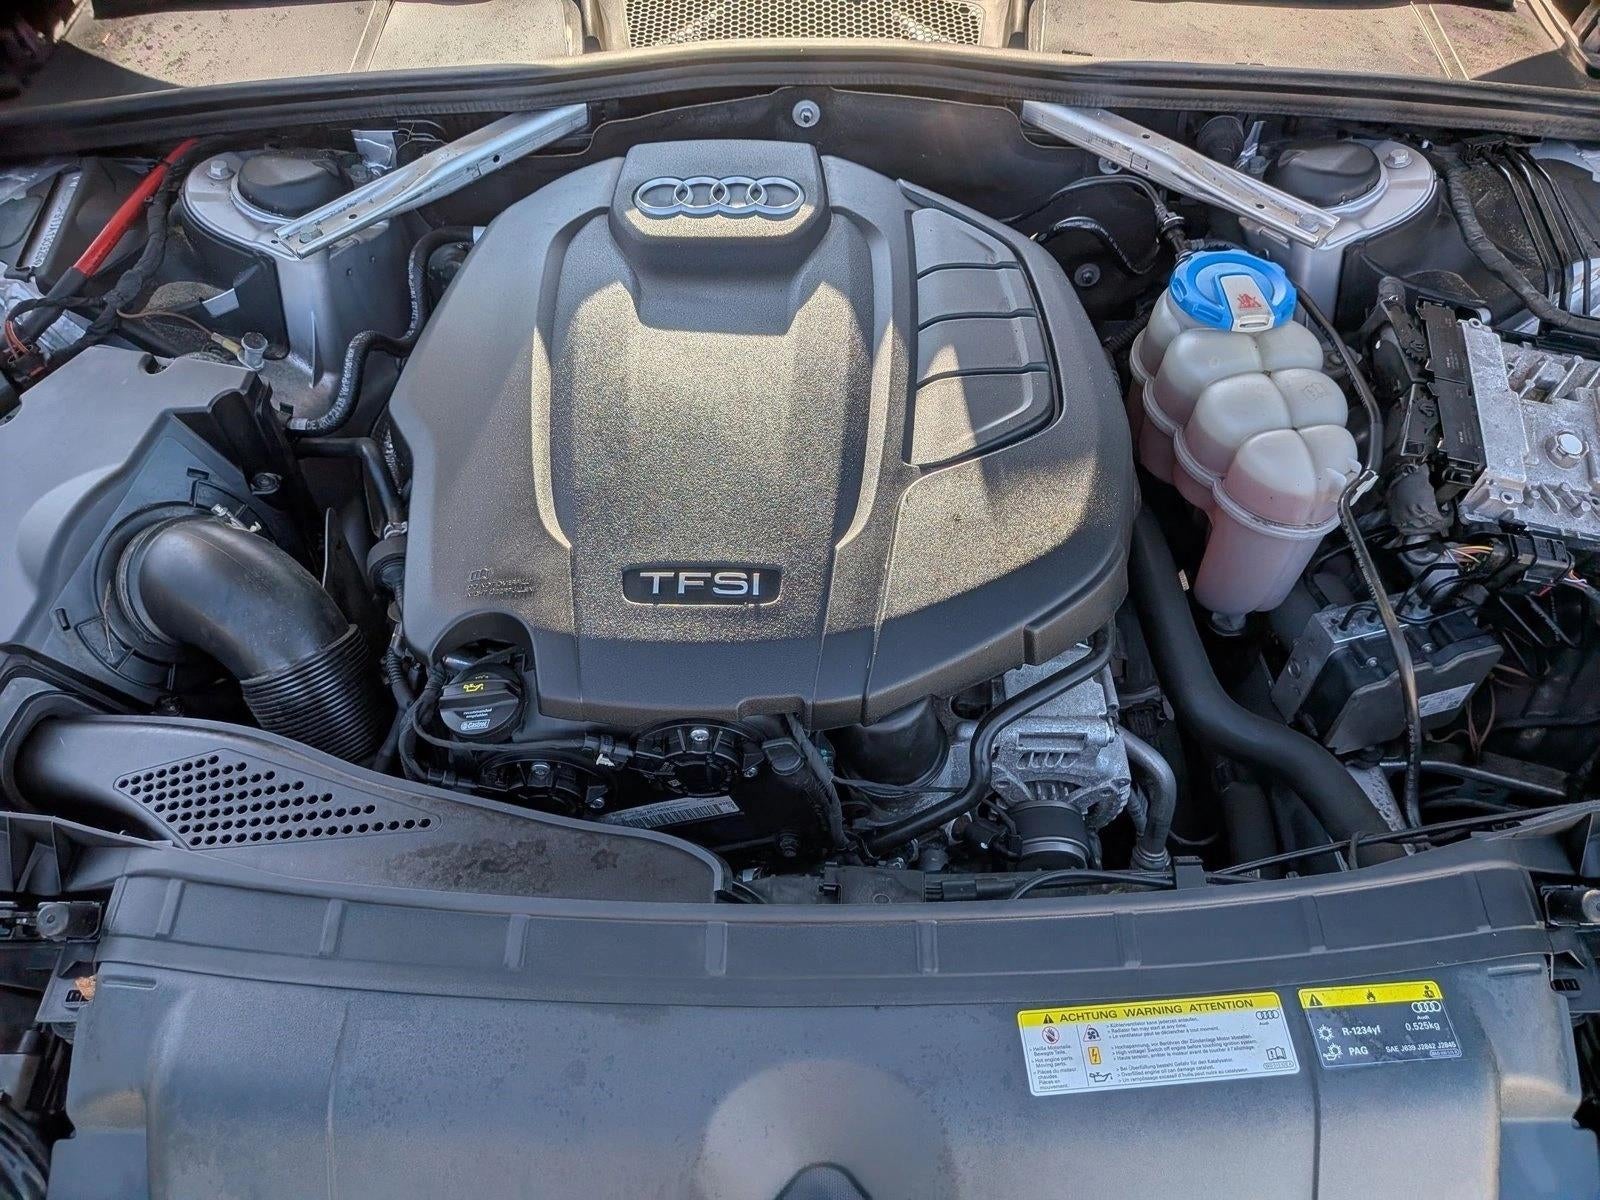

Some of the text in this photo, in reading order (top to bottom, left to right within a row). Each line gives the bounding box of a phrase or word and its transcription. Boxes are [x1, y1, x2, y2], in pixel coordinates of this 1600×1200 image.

[640, 572, 760, 596] TFSI
[1060, 1000, 1254, 1022] ACHTUNG WARNING ATTENTION
[1342, 1024, 1382, 1037] R-1234yf
[1405, 1021, 1441, 1032] 0.525kg
[1349, 1046, 1369, 1057] PAG
